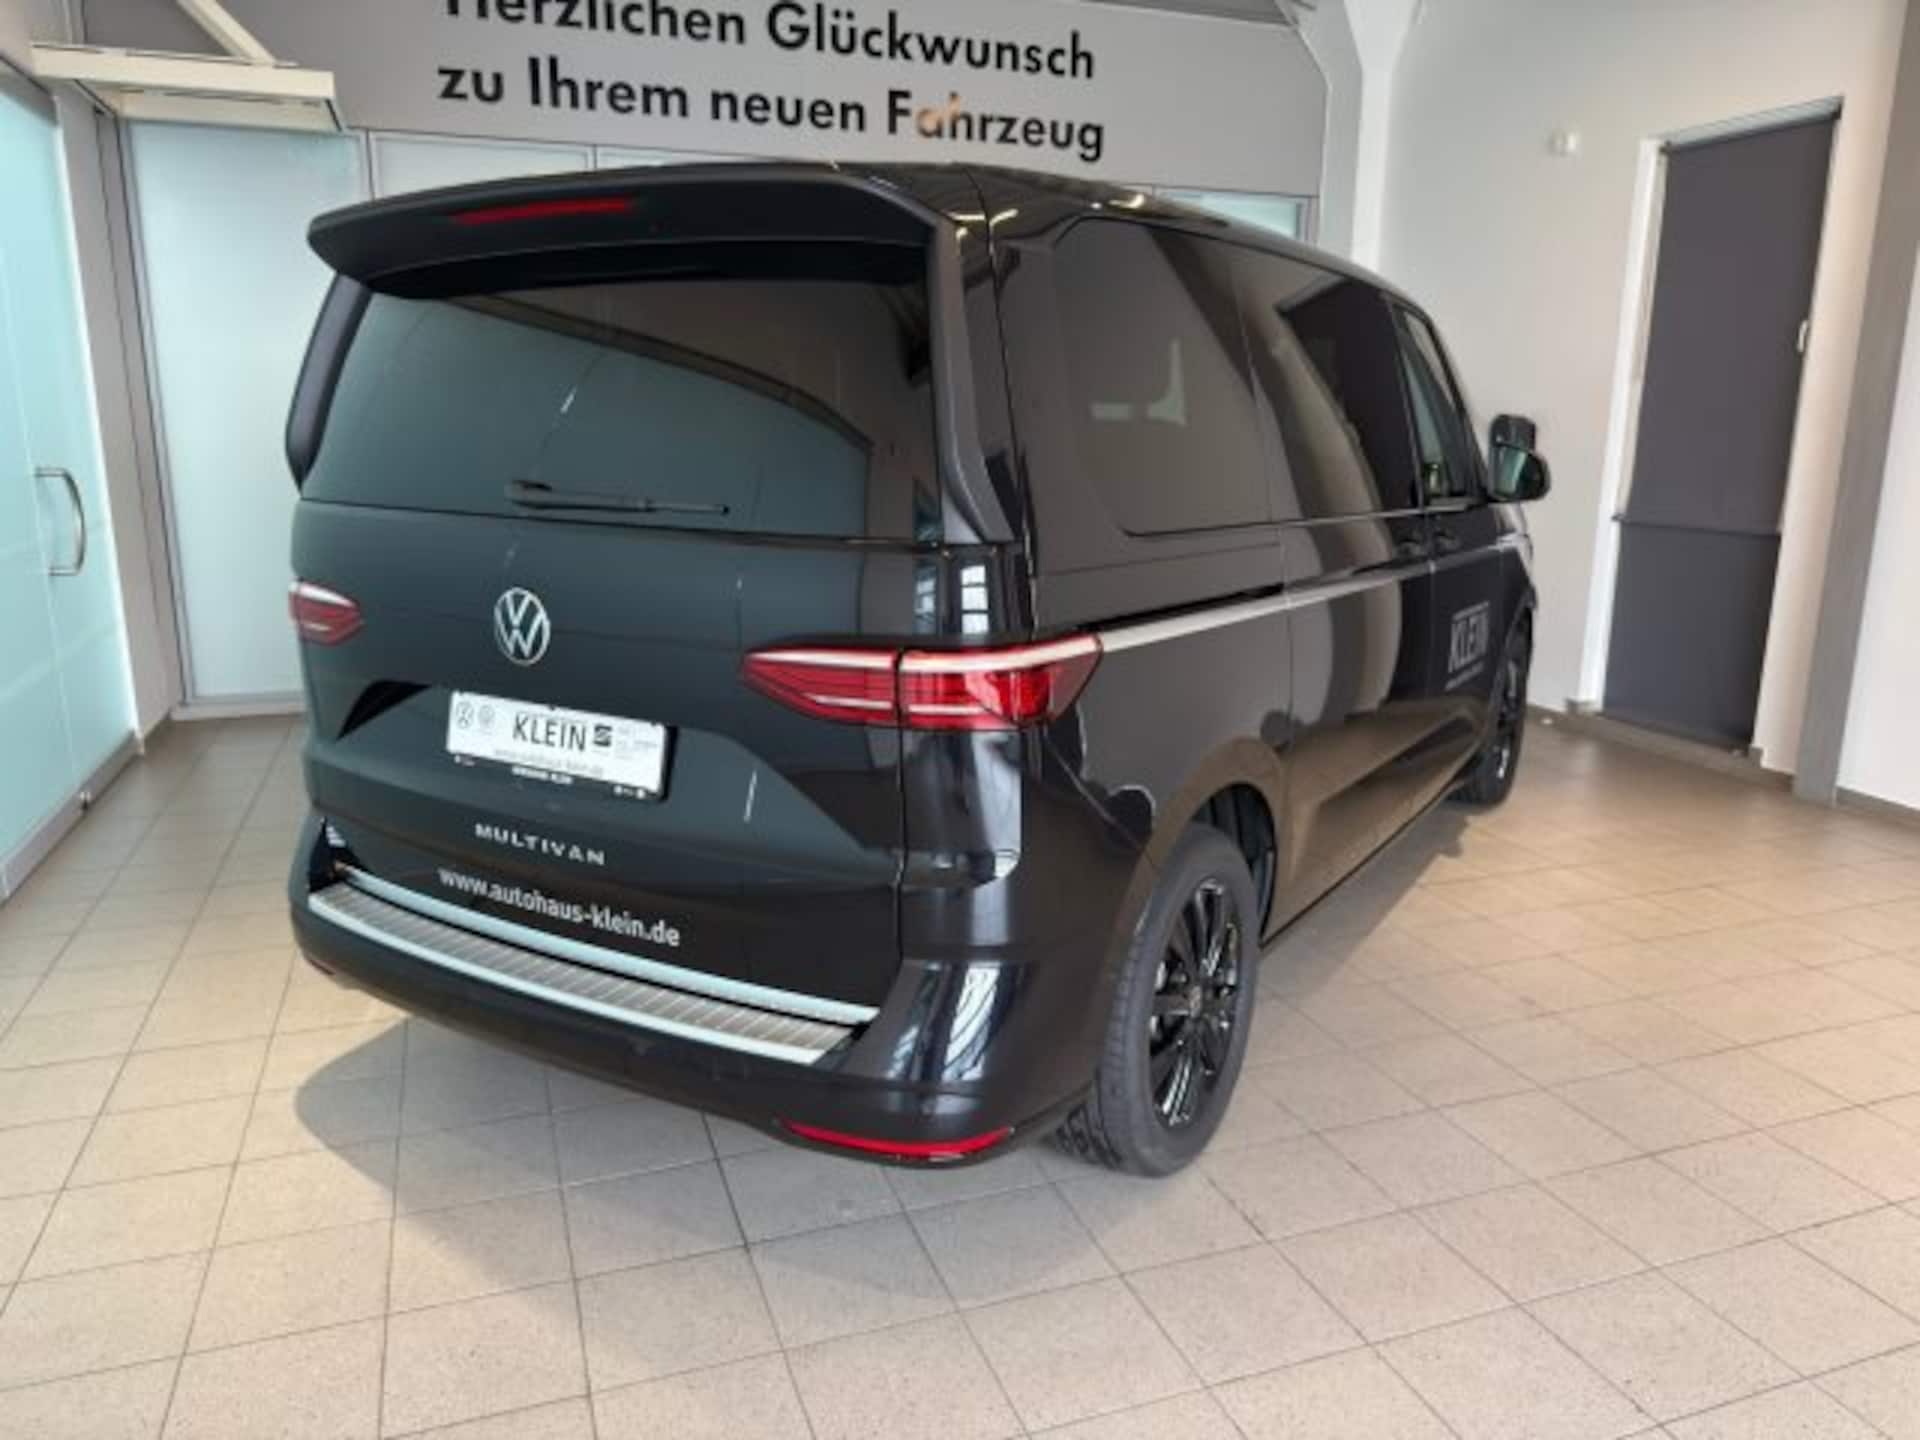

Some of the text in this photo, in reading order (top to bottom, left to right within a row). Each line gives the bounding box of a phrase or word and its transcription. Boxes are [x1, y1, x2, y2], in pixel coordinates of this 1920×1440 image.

[768, 1, 1094, 79] Glückwunsch
[437, 56, 1105, 163] zu Ihrem neuen Fahrzeug
[512, 713, 587, 751] KLEIN
[474, 823, 606, 866] MULTIVAN
[437, 868, 681, 947] www.autohaus-klein.de
